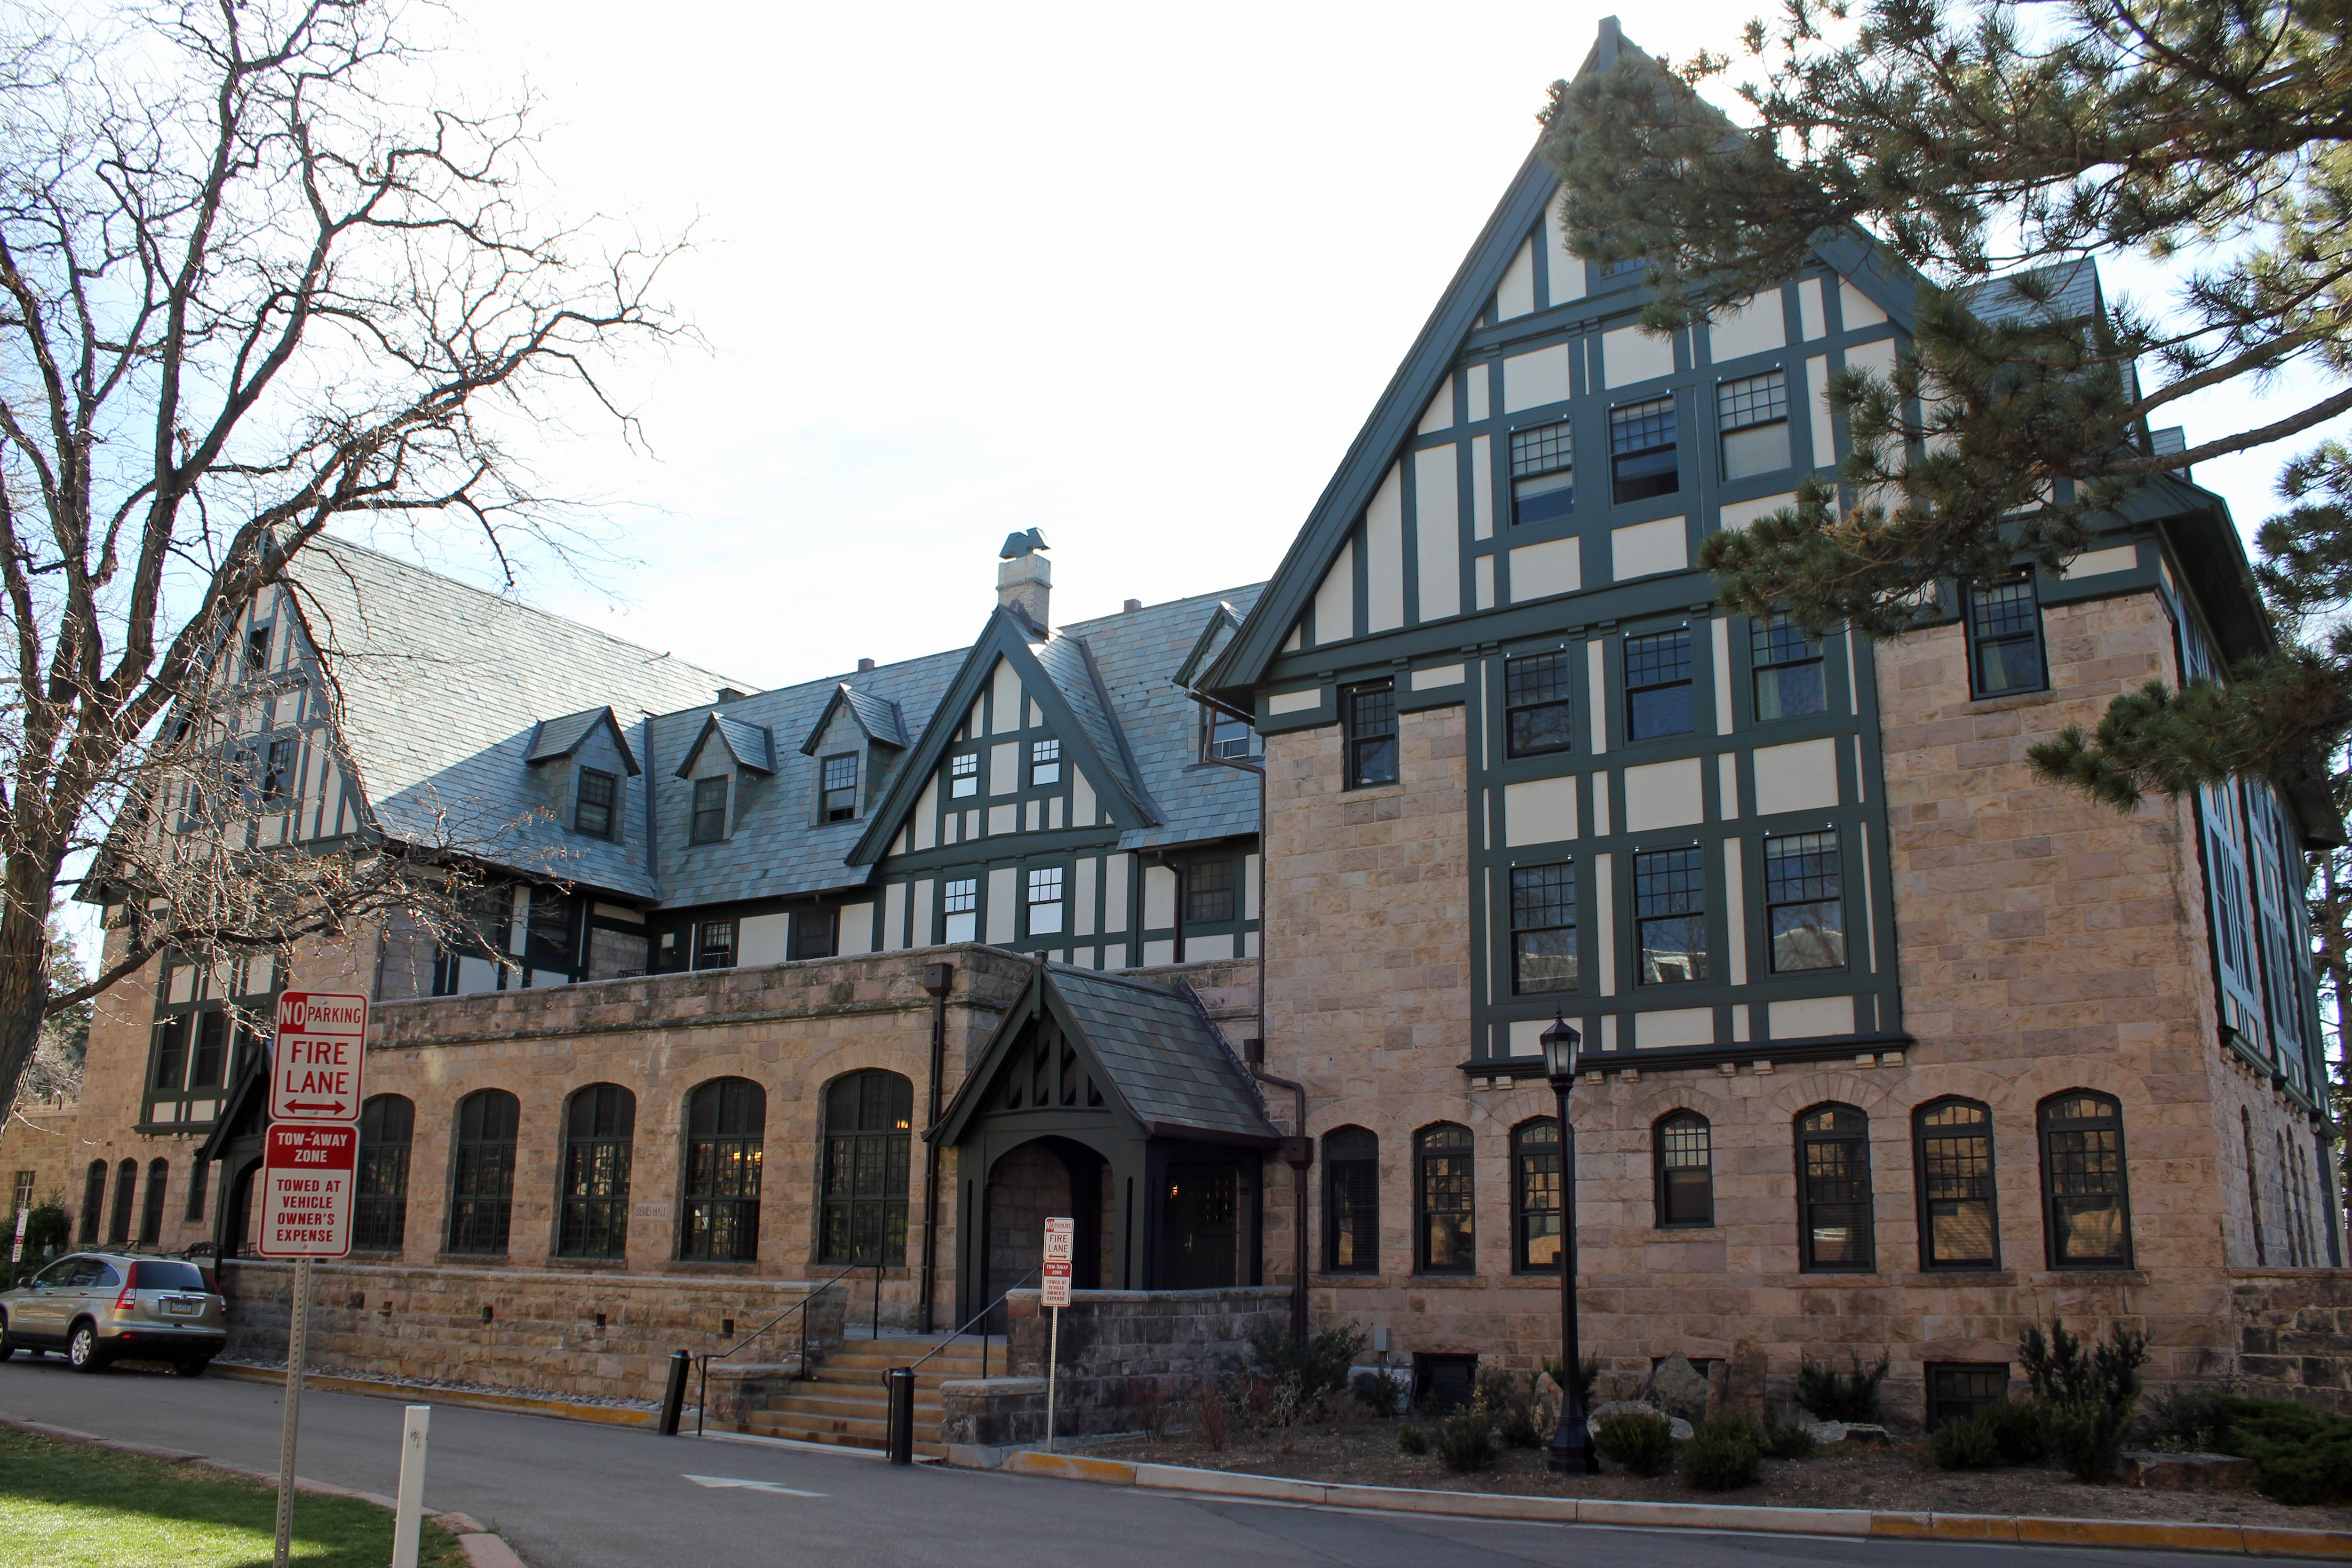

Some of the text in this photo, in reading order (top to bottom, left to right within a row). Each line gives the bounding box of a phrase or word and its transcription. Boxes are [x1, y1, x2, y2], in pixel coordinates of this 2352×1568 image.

[280, 1002, 361, 1025] NO PARKING
[292, 1041, 348, 1065] FIRE
[286, 1070, 349, 1094] LANE
[277, 1133, 348, 1146] TOW-AWAY
[294, 1150, 327, 1162] ZONE
[277, 1179, 341, 1192] TOWED AT
[283, 1196, 333, 1209] VEHICLE
[653, 1206, 666, 1217] HALL
[278, 1212, 334, 1225] OWNER'S
[1046, 1221, 1054, 1230] NO
[277, 1230, 333, 1242] EXPENSE
[2178, 1355, 2225, 1373] 1908
